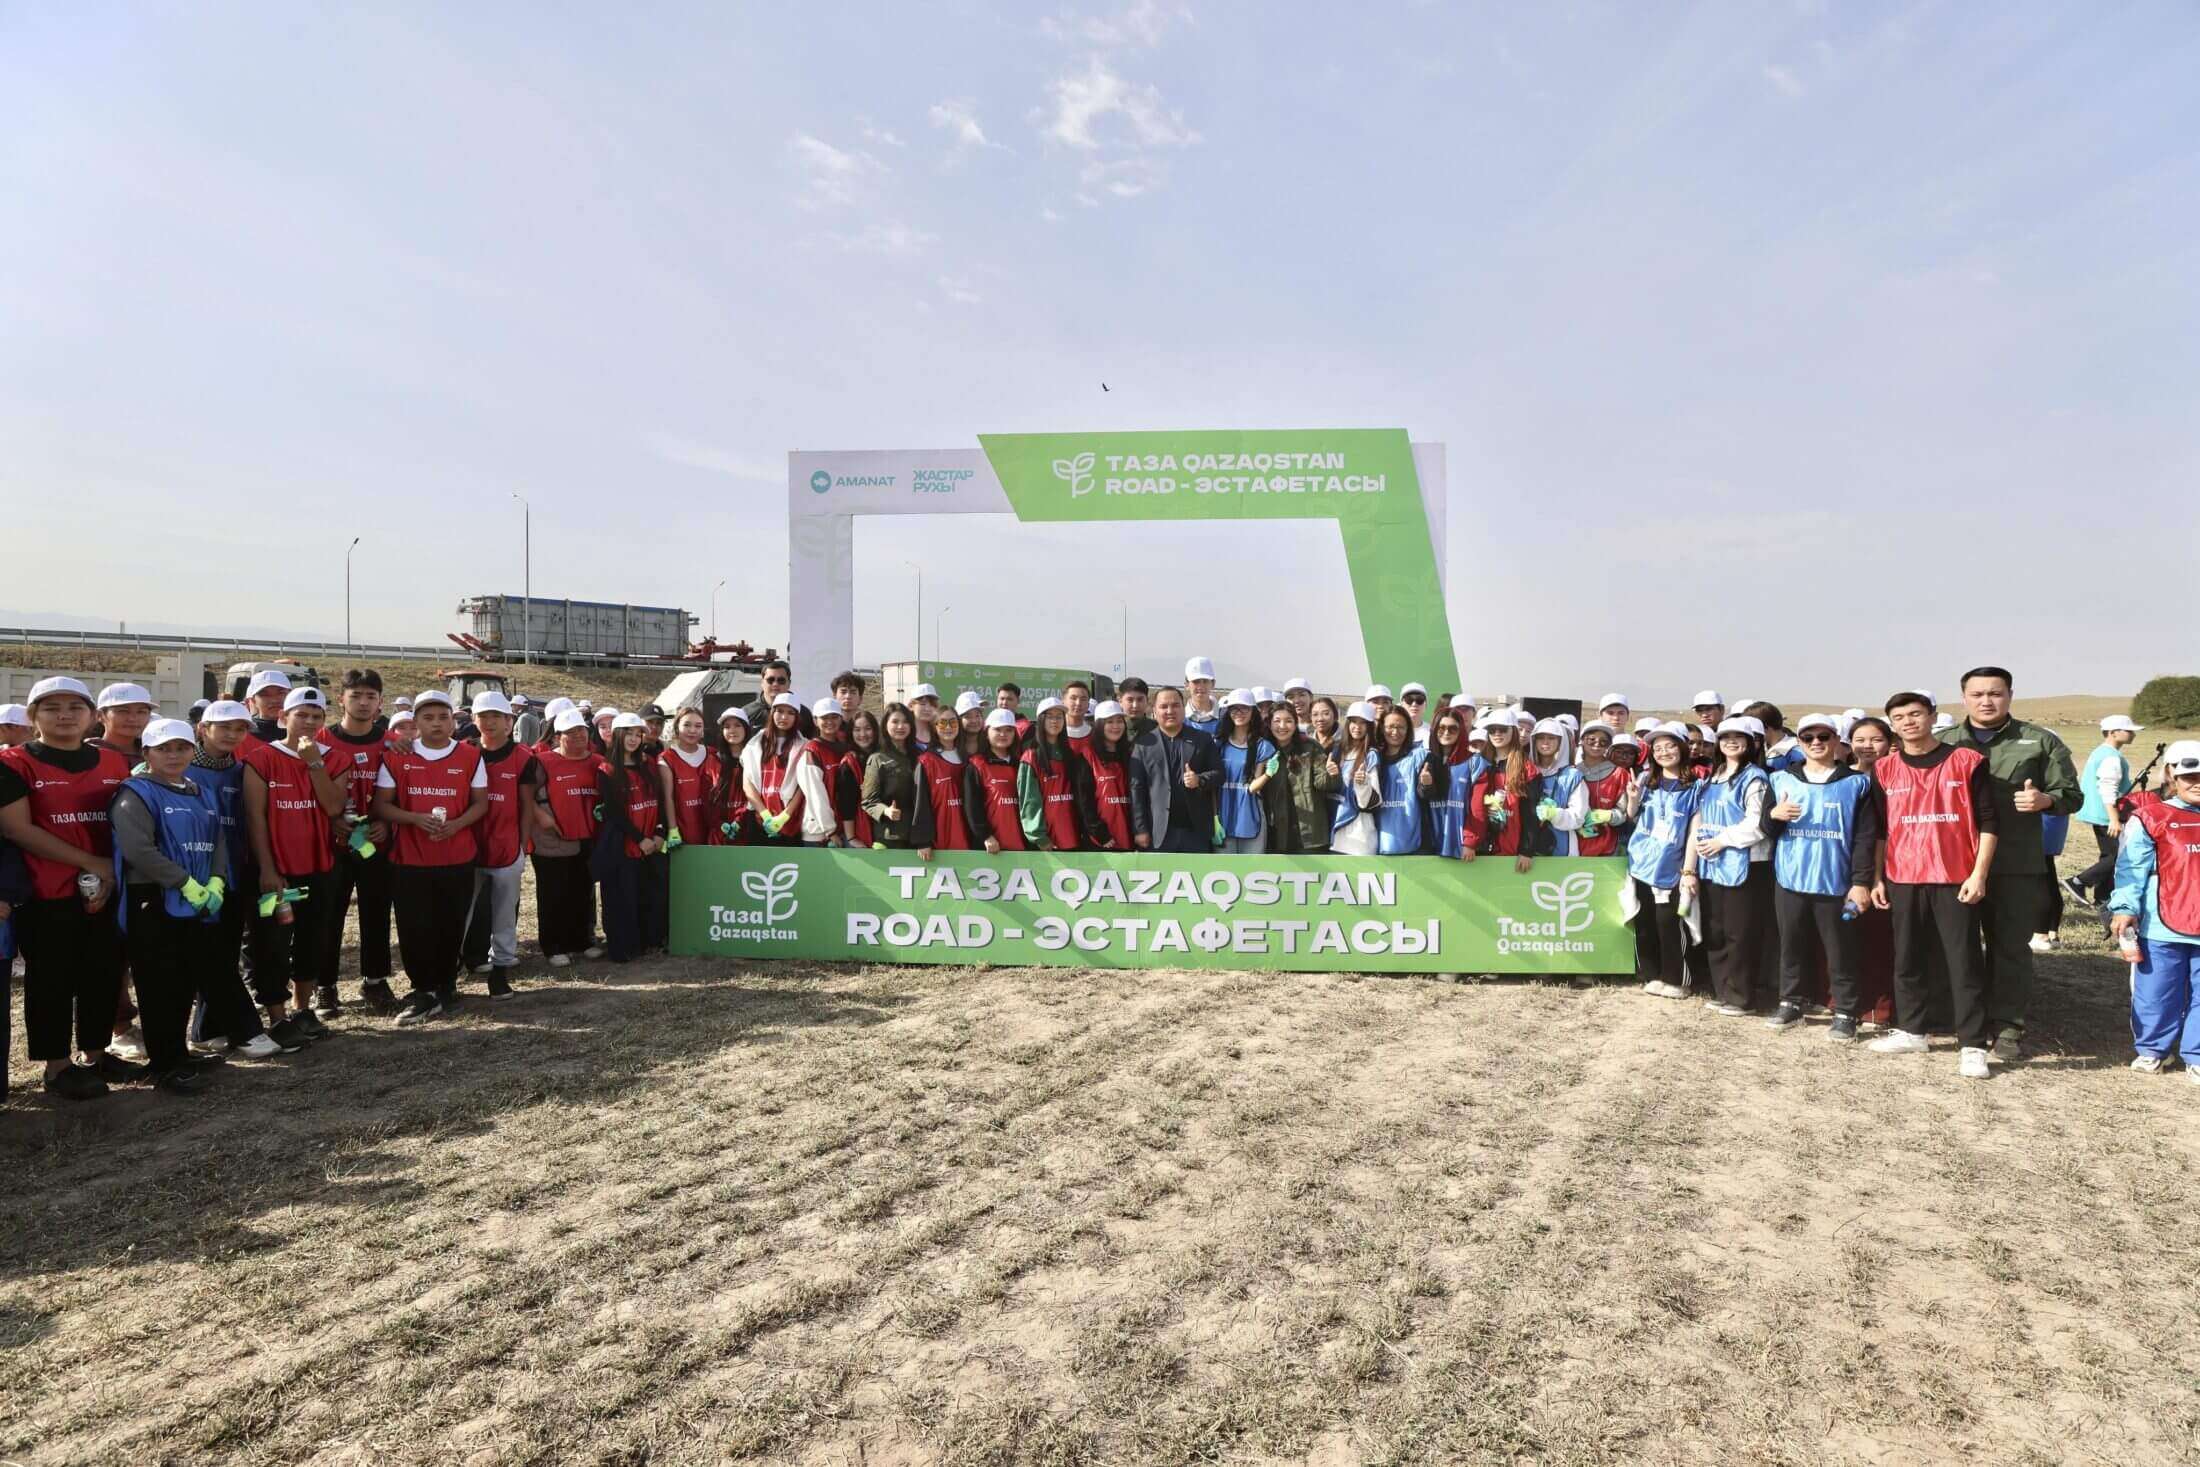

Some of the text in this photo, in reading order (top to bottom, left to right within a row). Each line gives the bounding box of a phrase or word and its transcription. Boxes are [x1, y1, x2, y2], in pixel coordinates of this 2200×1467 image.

[1105, 453, 1345, 474] ТАЗА QAZAQSTAN
[836, 476, 896, 487] AMANAT
[912, 470, 974, 481] ЖАСТАР
[1105, 478, 1176, 494] ROAD
[1195, 474, 1386, 493] ЭСТАФЕТАСЫ
[912, 482, 956, 493] РУХЫ
[50, 812, 76, 824] ТАЗА
[888, 867, 1398, 912] ТАЗА QAZAQSTAN
[709, 905, 763, 924] Таза
[709, 925, 798, 943] Qazaqstan
[847, 913, 994, 948] ROAD
[1033, 916, 1441, 954] ЭСТАФЕТАСЫ
[1497, 917, 1557, 936] Таза
[1497, 938, 1594, 956] Qazaqstan
